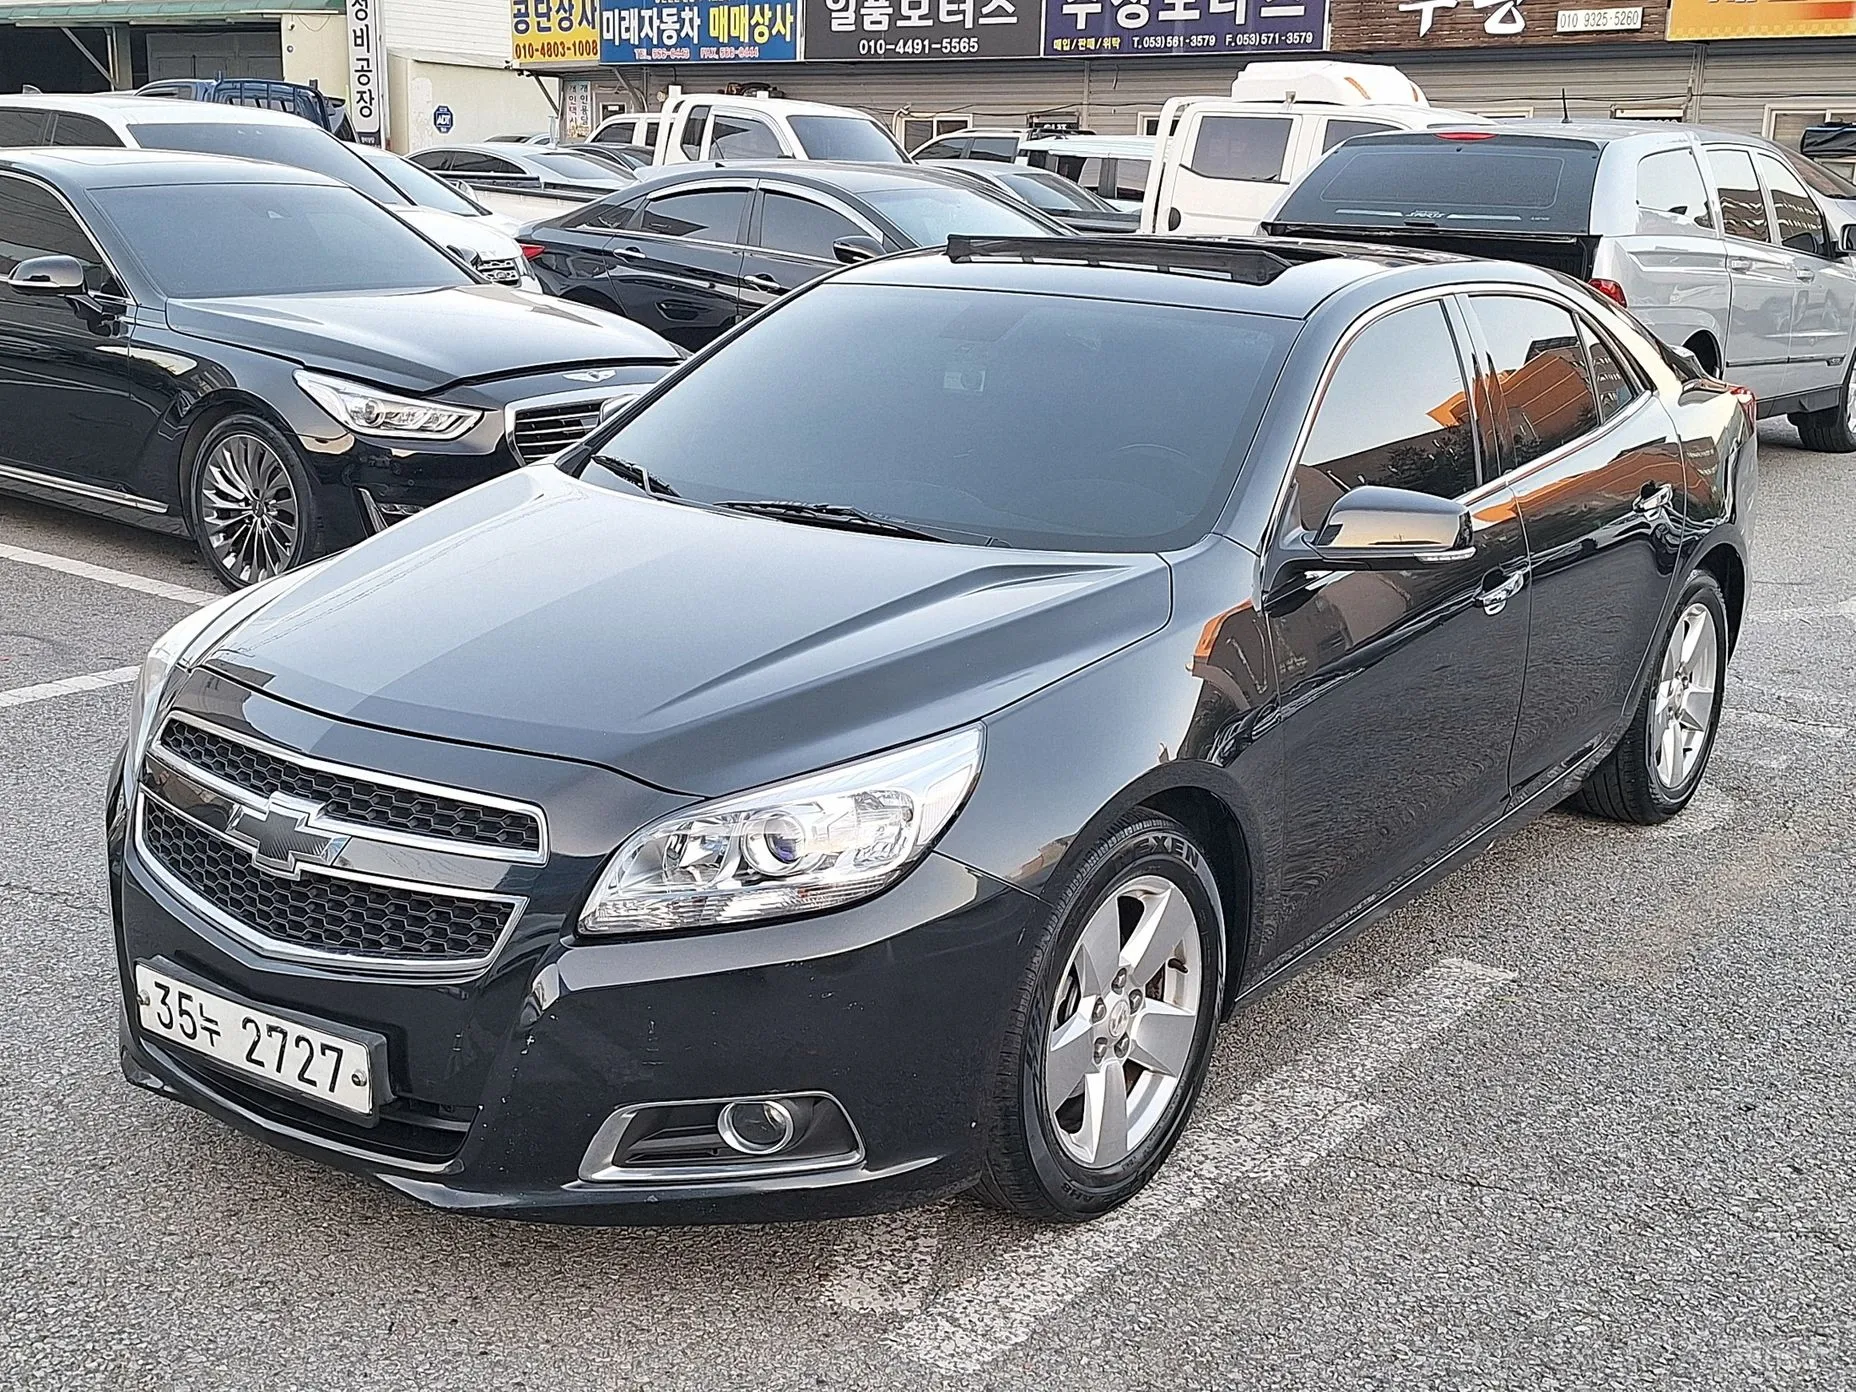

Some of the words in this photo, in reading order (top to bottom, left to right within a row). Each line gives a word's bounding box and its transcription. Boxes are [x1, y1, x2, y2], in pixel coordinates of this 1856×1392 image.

[513, 0, 597, 35] 공단상사
[602, 6, 701, 46] 미래자동차
[709, 3, 794, 44] 매매상사
[1560, 13, 1578, 28] 010
[515, 39, 598, 59] 010-4803-1008
[859, 37, 979, 55] 010-4491-5565
[153, 980, 222, 1048] 35누
[241, 1015, 344, 1093] 2727
